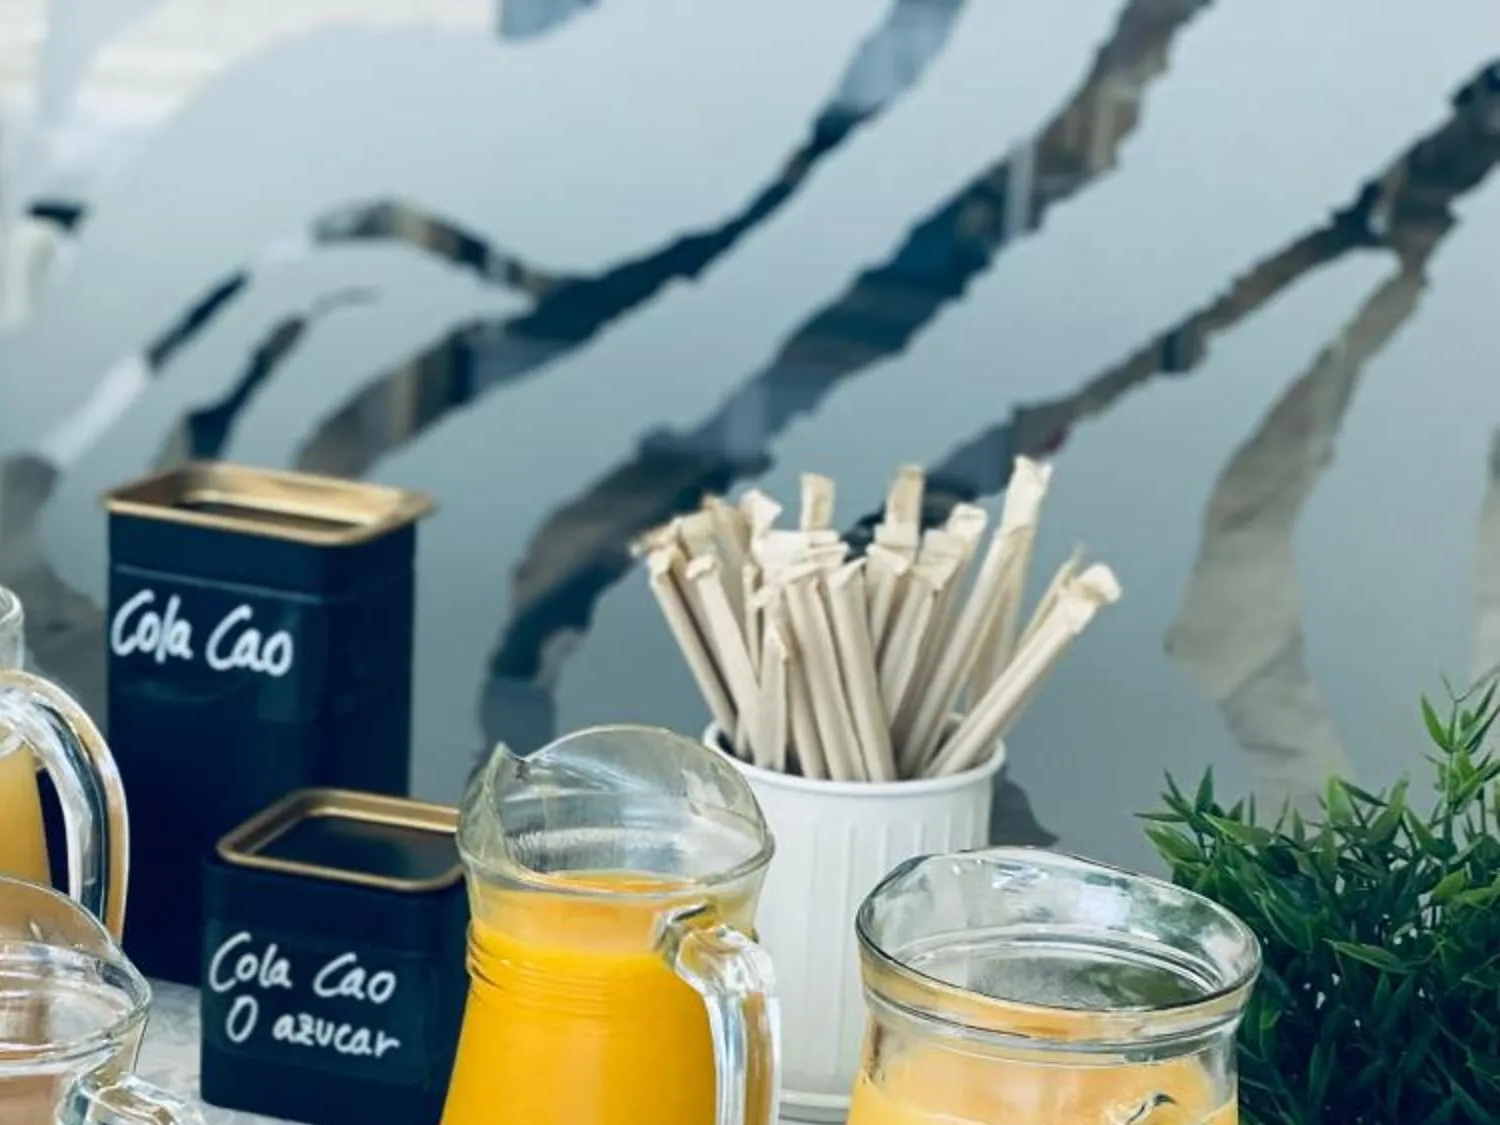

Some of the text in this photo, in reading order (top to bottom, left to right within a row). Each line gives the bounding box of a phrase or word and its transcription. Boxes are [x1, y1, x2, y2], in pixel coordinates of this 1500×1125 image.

[110, 588, 294, 677] Cola Cao
[208, 930, 396, 1004] Cola Cao
[271, 1011, 401, 1058] azucar
